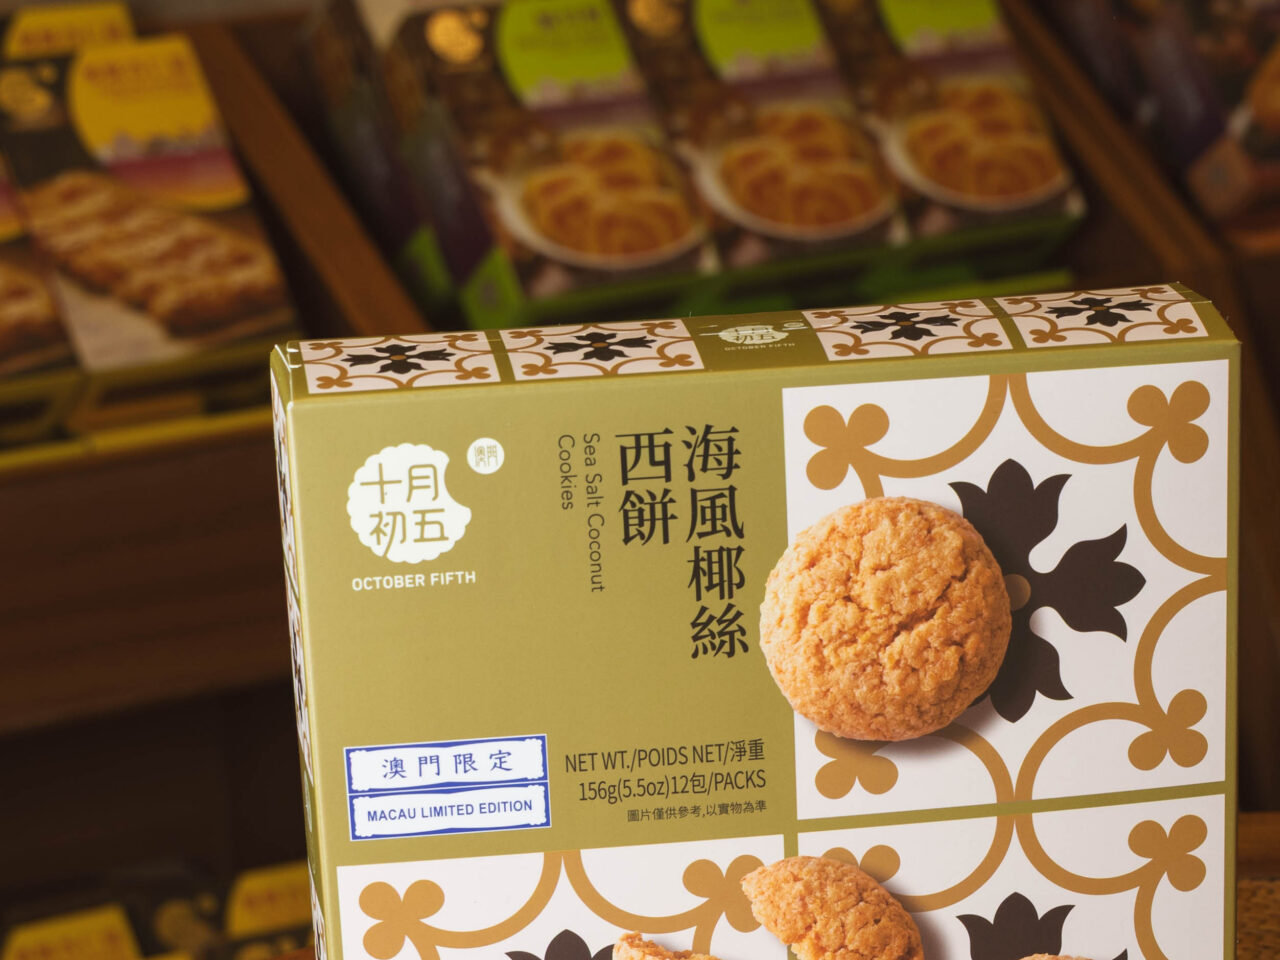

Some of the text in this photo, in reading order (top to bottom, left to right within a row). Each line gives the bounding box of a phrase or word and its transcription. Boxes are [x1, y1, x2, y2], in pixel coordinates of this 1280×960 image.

[360, 463, 439, 504] 十月
[558, 434, 577, 510] Cookies
[615, 427, 679, 546] 西餅
[369, 508, 449, 557] 初五
[583, 432, 605, 593] Sea Salt Coconut
[681, 424, 749, 659] 海風椰絲
[352, 571, 476, 591] OCTOBER FIFTH
[381, 750, 513, 780] 澳門限定
[565, 738, 765, 773] NET WT./POIDS NET/淨重
[579, 769, 766, 804] 156g(5.5oz)12包/PACKS
[367, 800, 532, 822] MACAU LIMITED EDITION
